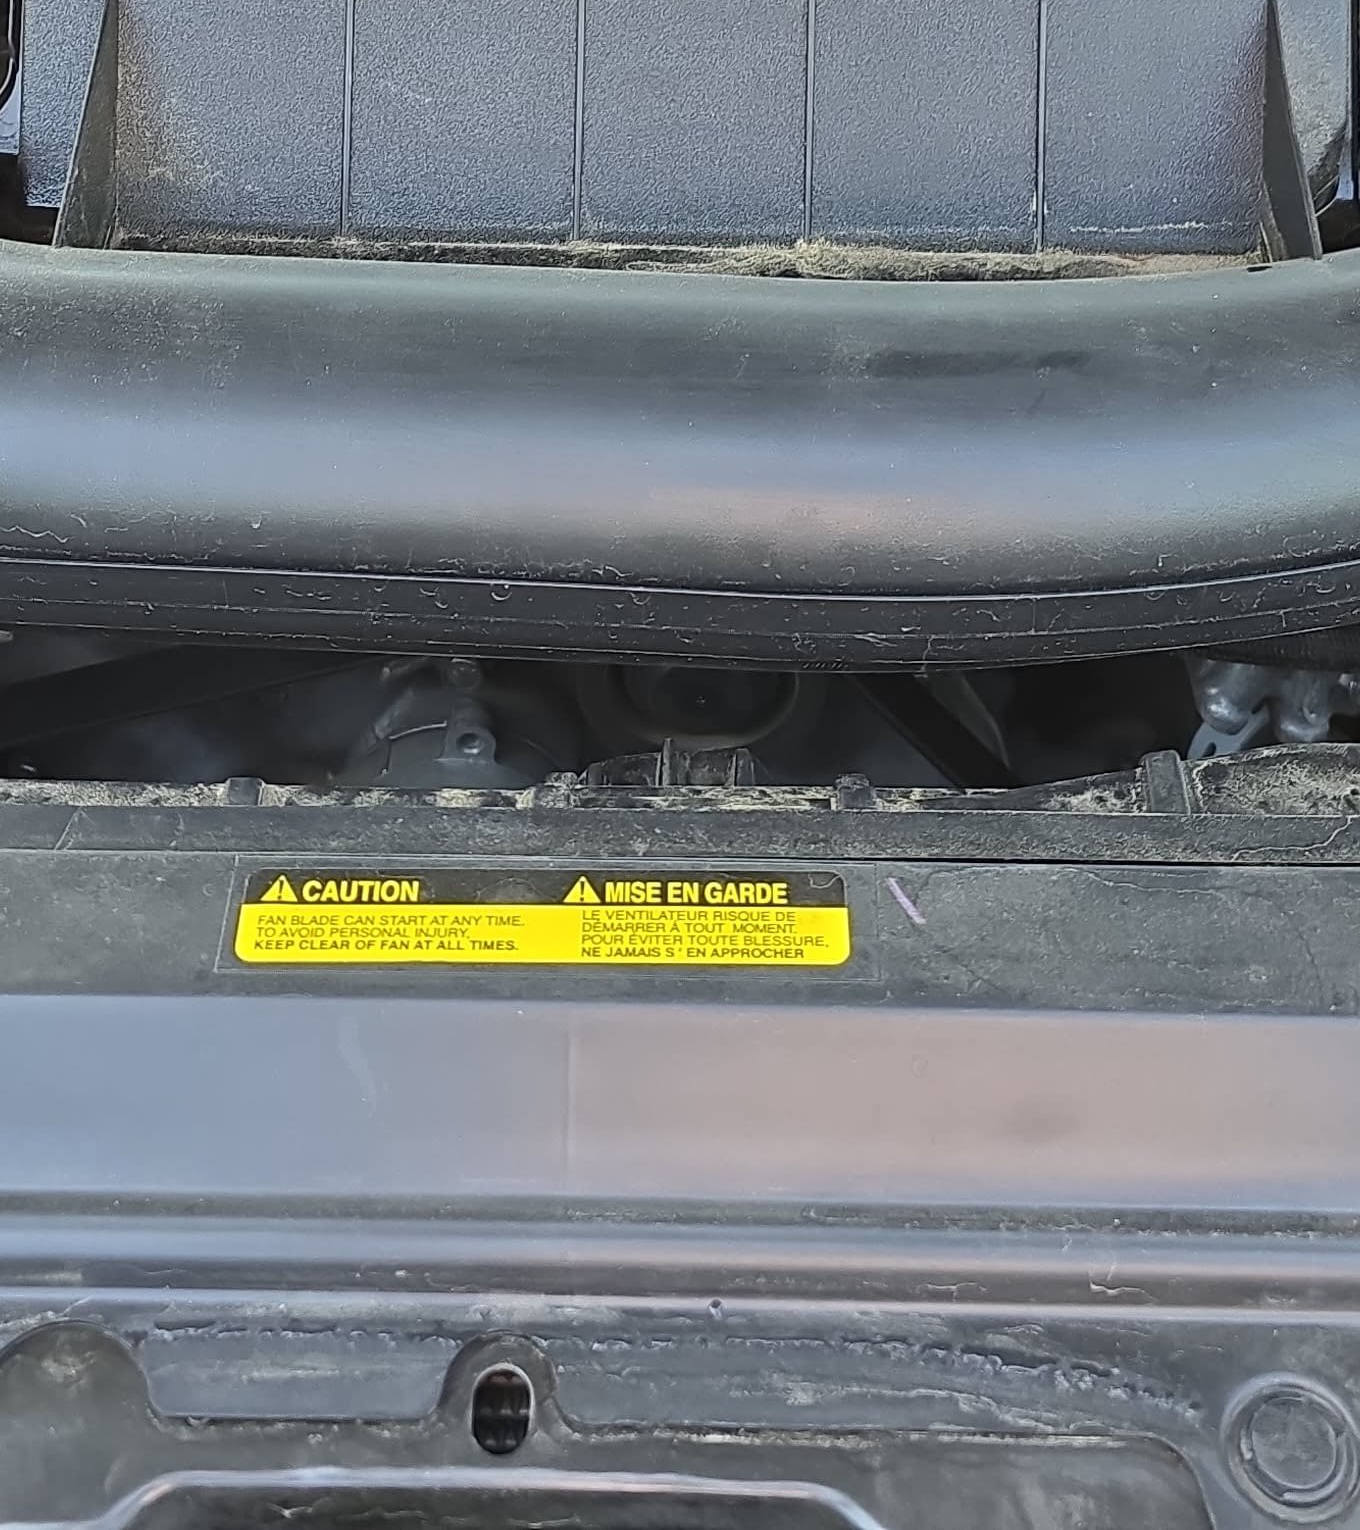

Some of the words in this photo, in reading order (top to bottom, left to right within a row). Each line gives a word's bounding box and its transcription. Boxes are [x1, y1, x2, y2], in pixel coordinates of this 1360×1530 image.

[302, 880, 420, 902] CAUTION
[605, 881, 661, 903] MISE
[667, 882, 698, 903] EN
[704, 882, 788, 904] GARDE
[258, 915, 286, 925] FAN
[291, 915, 338, 925] BLADE
[344, 915, 376, 925] CAN
[379, 915, 425, 925] START
[429, 915, 448, 925] AT
[451, 915, 482, 925] ANY
[582, 910, 599, 920] LE
[605, 910, 708, 921] VENTILATEUR
[713, 911, 770, 922] RISQUE
[776, 911, 796, 922] DE
[257, 927, 276, 937] TO
[279, 927, 325, 937] AVOID
[330, 927, 408, 938] PERSONAL
[582, 920, 665, 933] DÉMARRER
[686, 923, 723, 933] TOUT
[581, 934, 623, 944] POUR
[629, 932, 683, 945] ÉVITER
[690, 935, 738, 945] TOUTE
[254, 940, 294, 949] KEEP
[299, 940, 349, 950] CLEAR
[355, 940, 376, 950] OF
[381, 940, 408, 950] FAN
[414, 940, 433, 950] AT
[437, 940, 465, 950] ALL
[581, 947, 600, 957] NE
[605, 948, 661, 958] JAMAIS
[711, 948, 804, 959] APPROCHER
